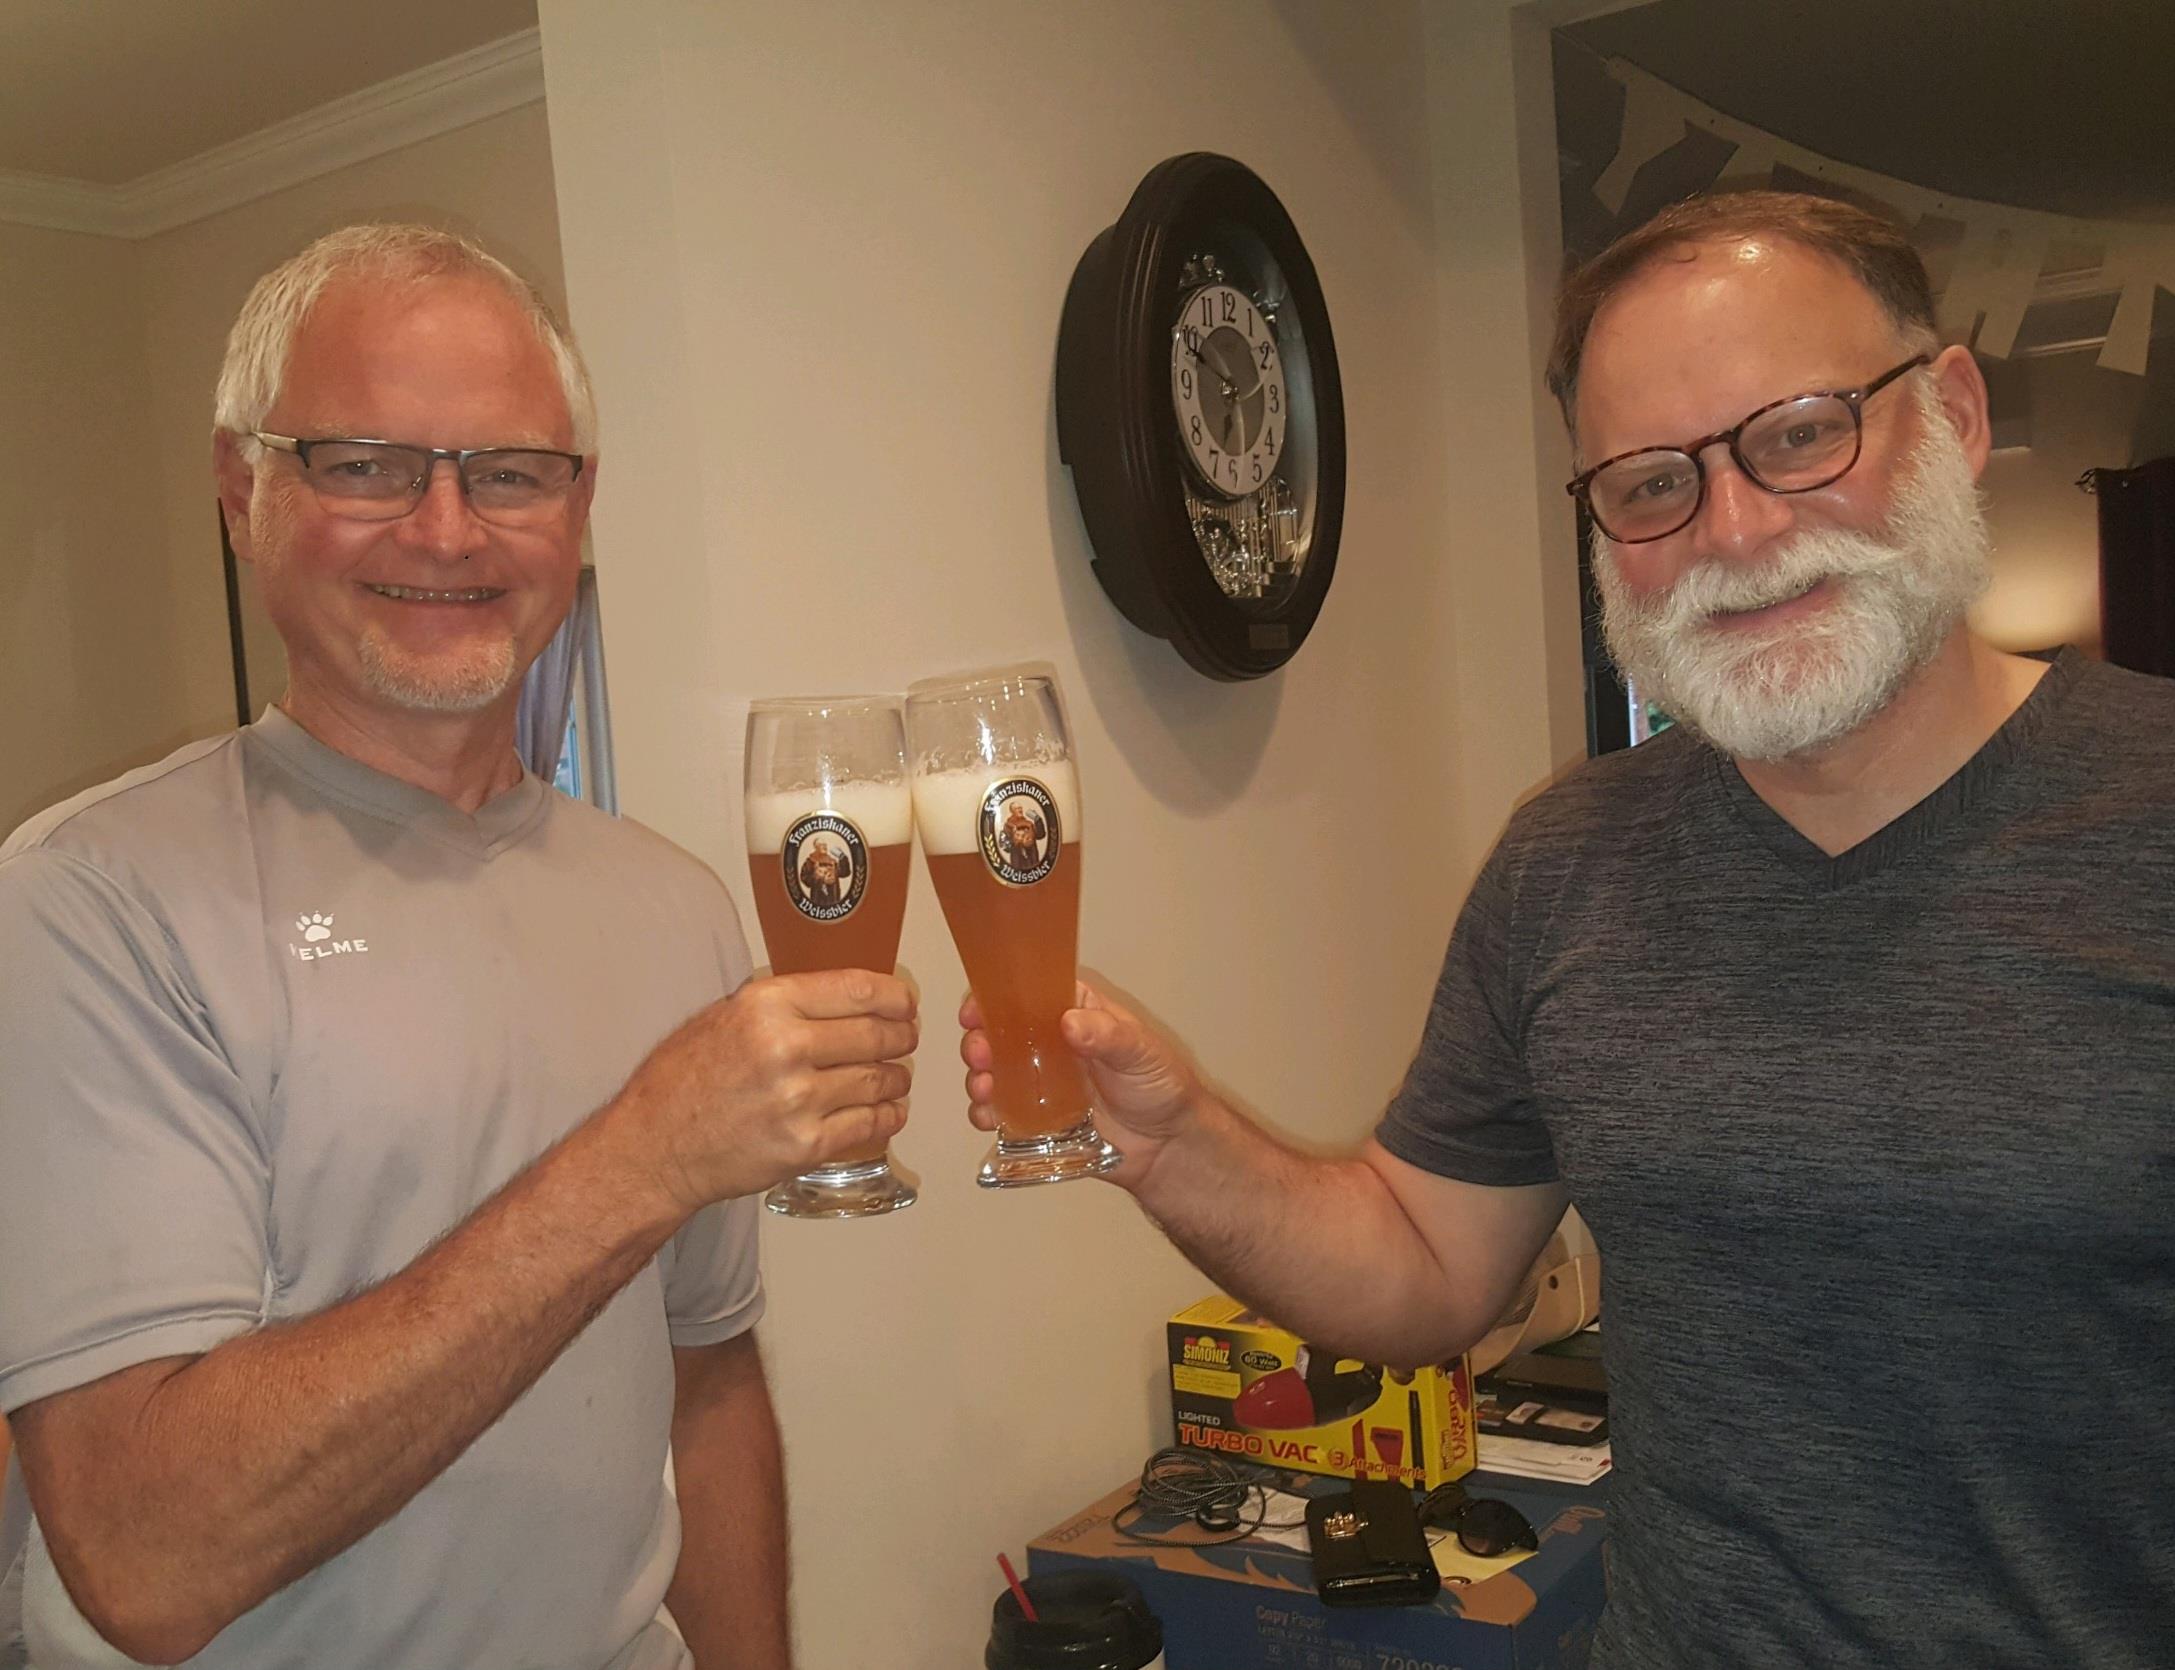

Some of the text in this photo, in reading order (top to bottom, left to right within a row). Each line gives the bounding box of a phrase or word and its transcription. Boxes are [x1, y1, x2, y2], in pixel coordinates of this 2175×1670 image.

[1220, 291, 1237, 324] 12
[1246, 307, 1254, 338] 1
[1258, 340, 1272, 371] 2
[1180, 370, 1193, 400] 9
[1268, 384, 1280, 414] 3
[1190, 415, 1201, 446] 8
[1263, 425, 1275, 456] 4
[1208, 449, 1220, 479] 7
[1251, 454, 1263, 483] 5
[788, 817, 860, 847] Franziskaner
[999, 860, 1051, 884] Weissbier
[798, 897, 853, 921] Weissbier
[1183, 1344, 1230, 1365] SIMONIZ
[1178, 1410, 1221, 1426] LIGHTED
[1178, 1422, 1320, 1464] TURBO VAC
[1256, 1605, 1287, 1627] Copy
